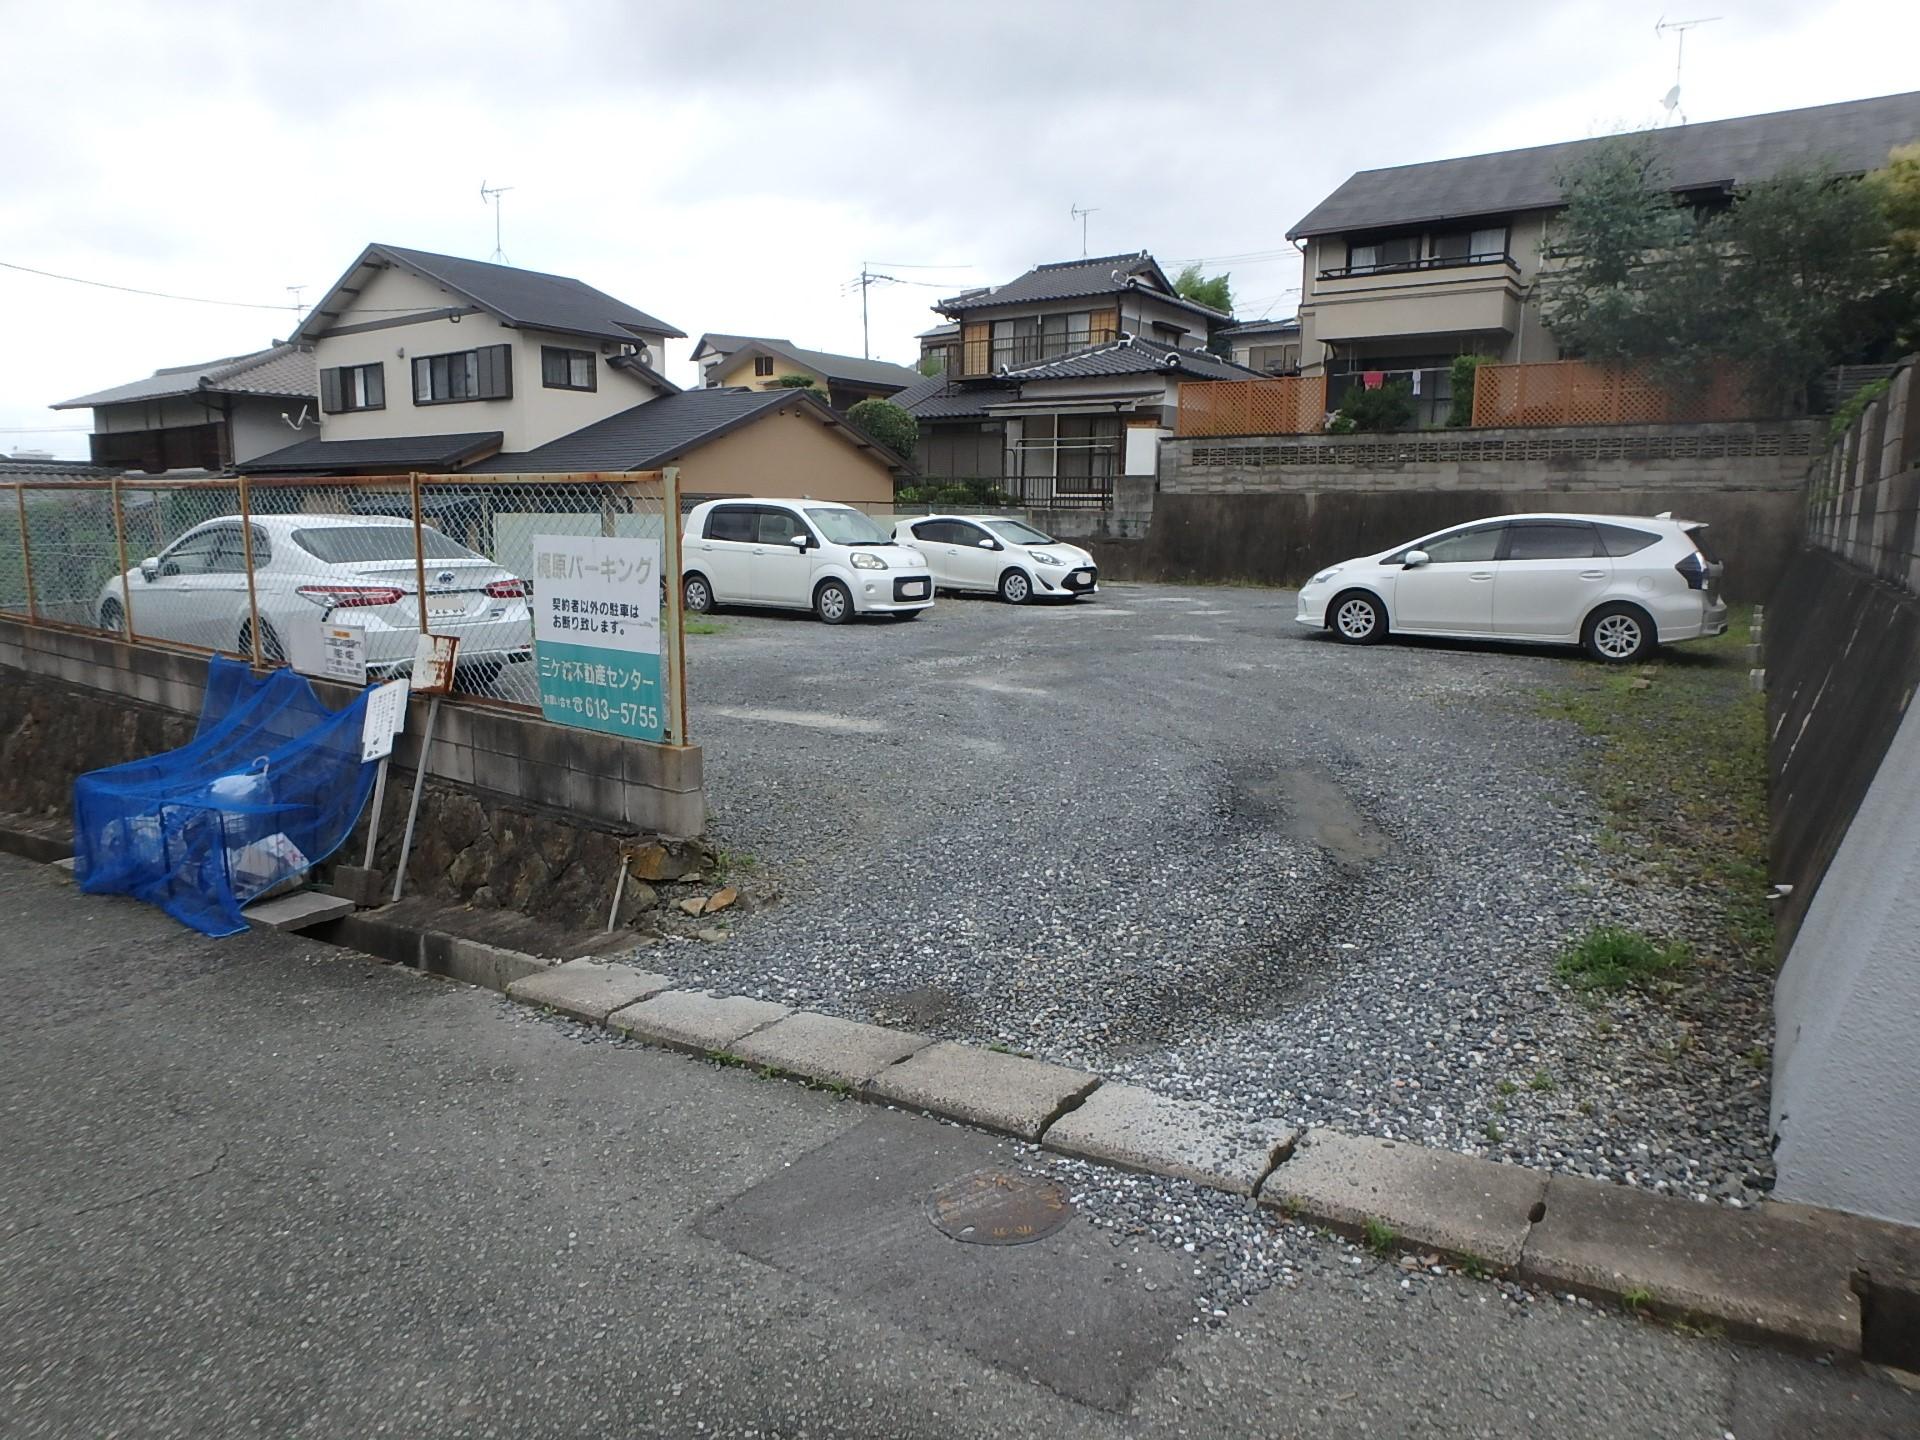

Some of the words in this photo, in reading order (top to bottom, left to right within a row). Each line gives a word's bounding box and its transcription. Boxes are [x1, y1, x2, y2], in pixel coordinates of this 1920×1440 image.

[552, 597, 639, 618] 契約者以外の駐車は
[552, 614, 625, 635] お断り致します。
